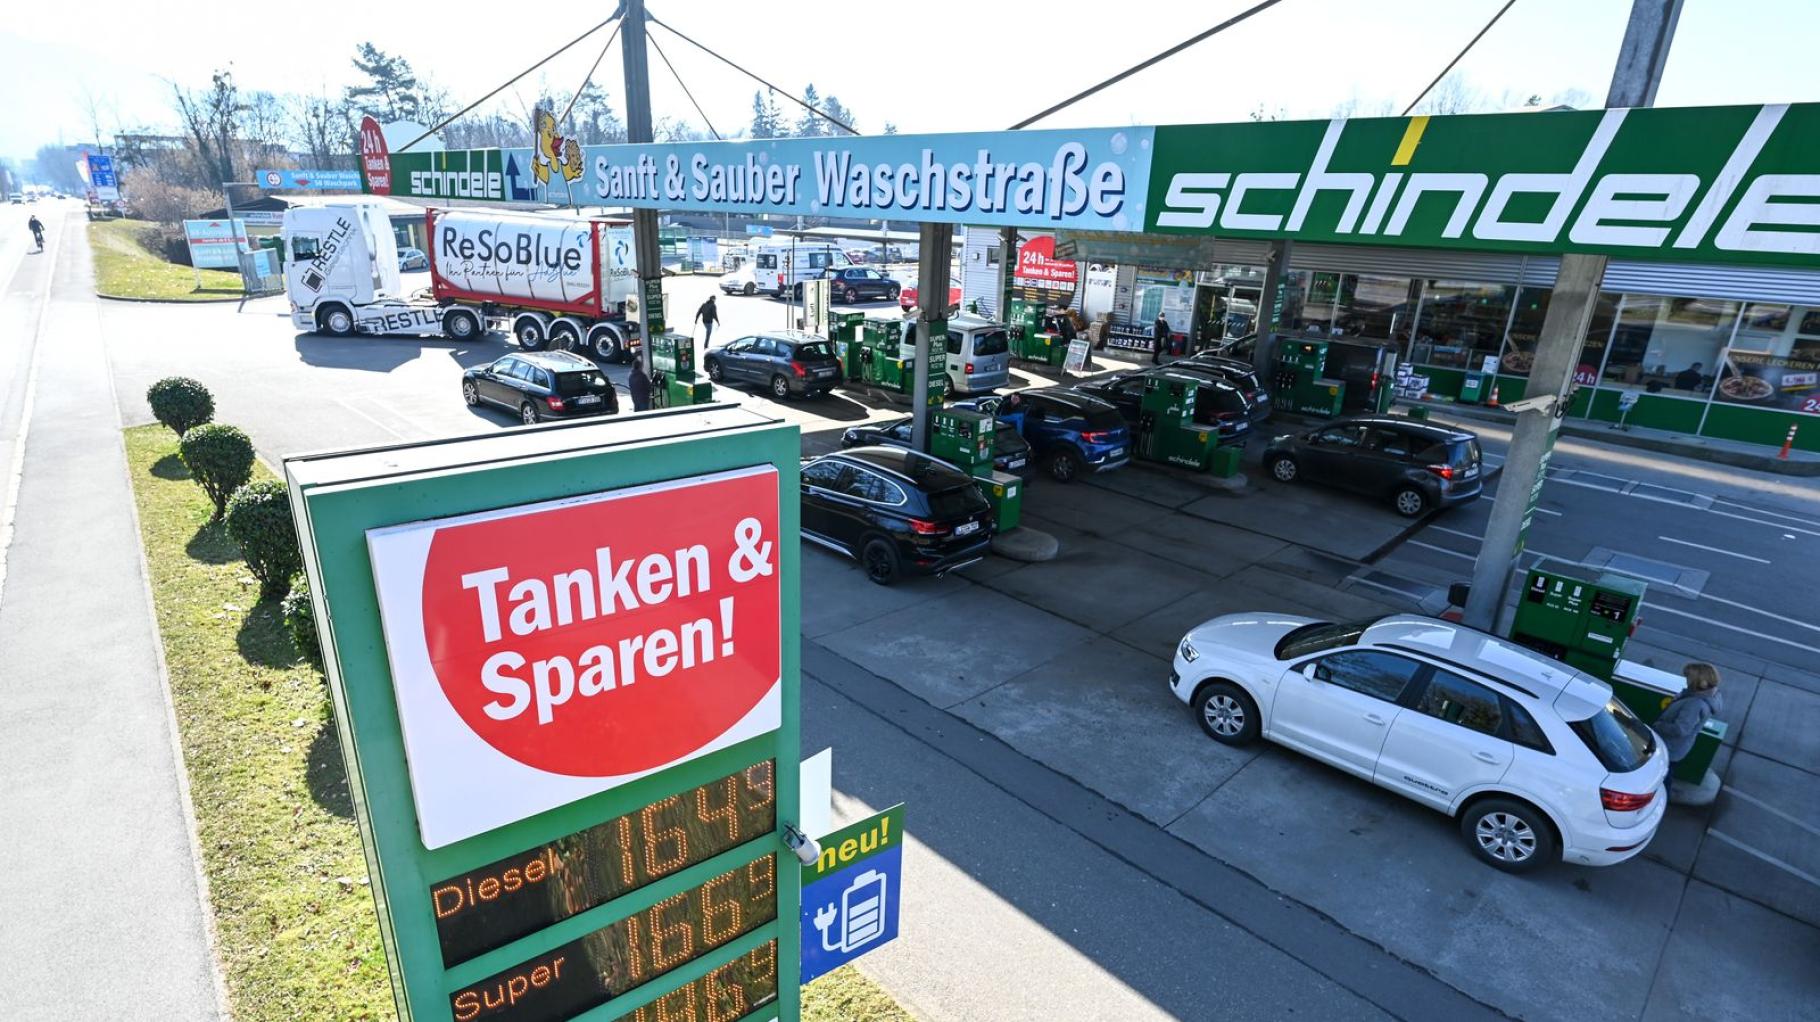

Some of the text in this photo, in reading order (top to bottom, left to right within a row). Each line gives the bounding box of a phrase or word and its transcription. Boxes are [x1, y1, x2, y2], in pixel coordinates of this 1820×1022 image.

[361, 129, 382, 153] 24 h
[411, 150, 501, 198] schindele
[595, 142, 1126, 220] Sanft & Sauber Waschstraße
[1157, 103, 1820, 254] schindele
[311, 216, 351, 273] RESTLE
[443, 226, 582, 271] ReSoBlue
[460, 260, 504, 278] Partner
[1023, 251, 1037, 265] 24
[1037, 252, 1045, 265] h
[1023, 266, 1075, 279] Tanken & Sparen!
[1586, 373, 1595, 384] h
[461, 517, 775, 644] Tanken &
[480, 596, 736, 726] Sparen!
[1403, 775, 1449, 796] quattro
[817, 816, 889, 873] neu!
[433, 848, 554, 919] Diesel
[454, 956, 565, 1021] Super
